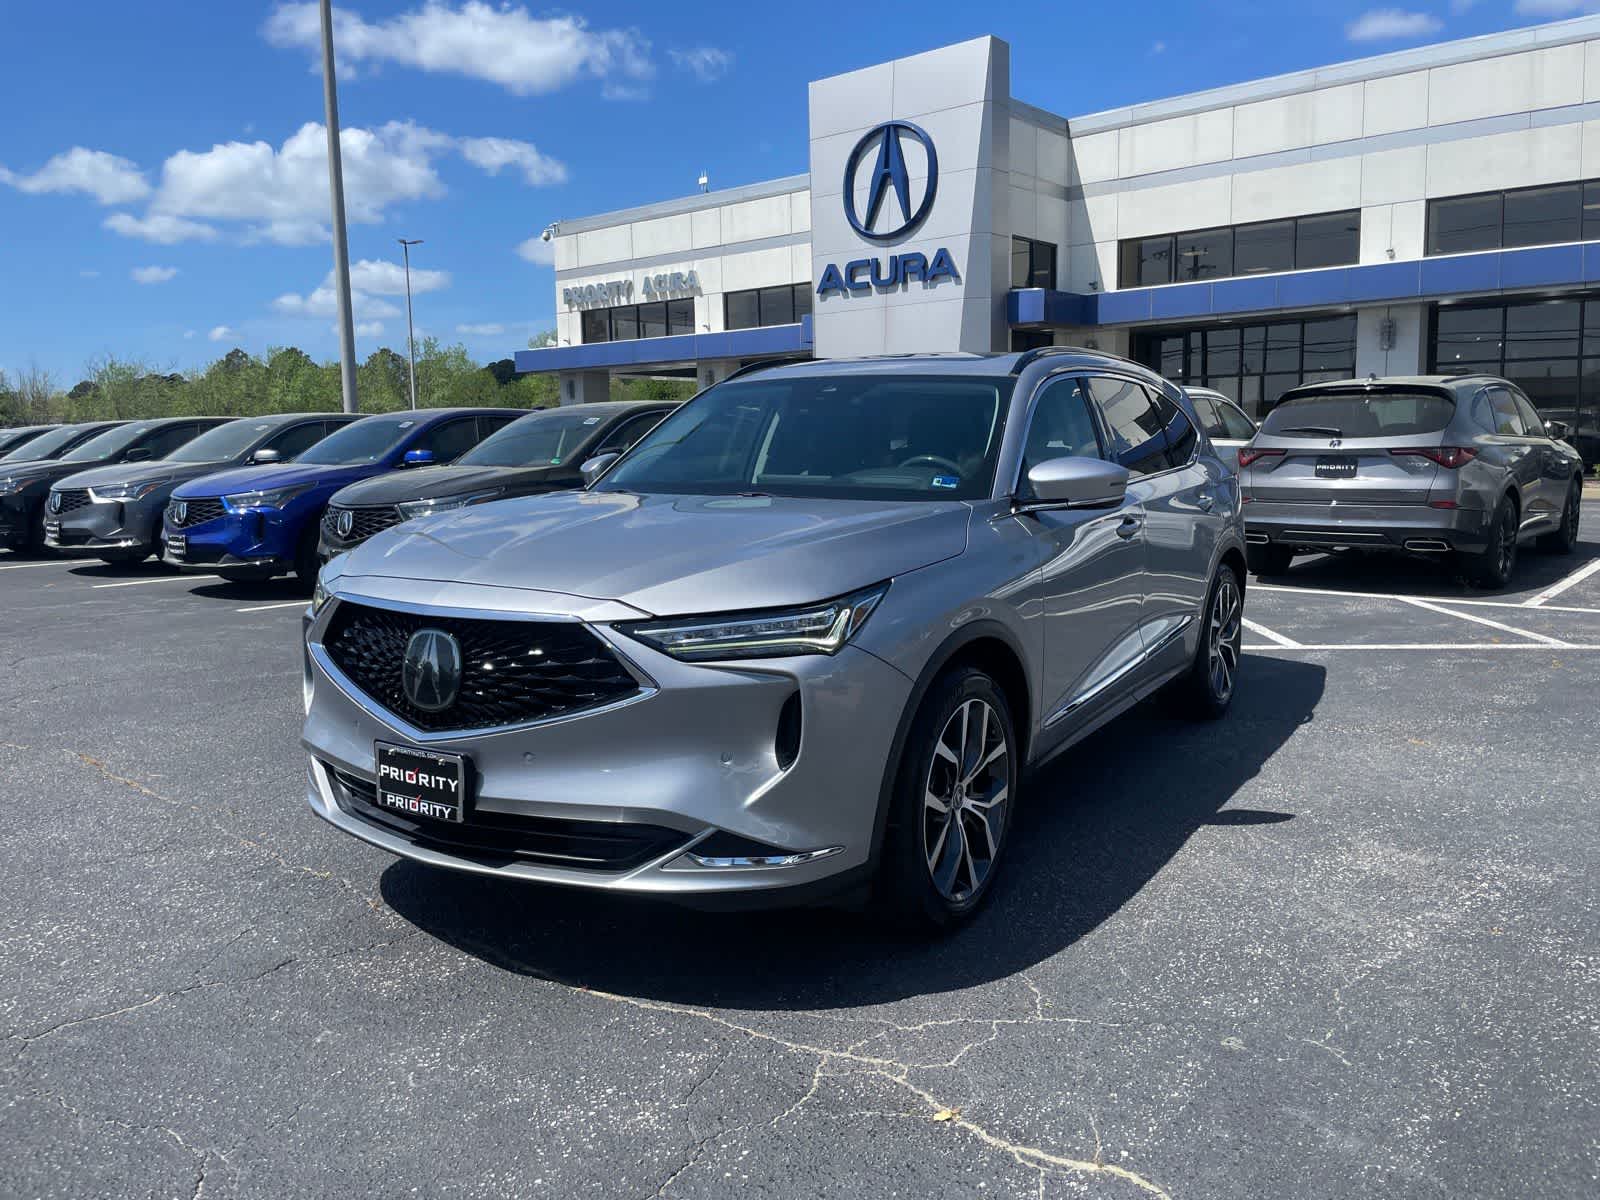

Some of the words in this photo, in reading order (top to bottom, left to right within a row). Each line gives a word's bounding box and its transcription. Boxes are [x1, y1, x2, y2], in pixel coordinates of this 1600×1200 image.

[816, 247, 961, 294] ACURA
[563, 280, 634, 305] PRIORITY
[642, 270, 701, 297] ACURA
[380, 764, 458, 793] PRIORITY
[386, 794, 452, 819] PRIORITY
